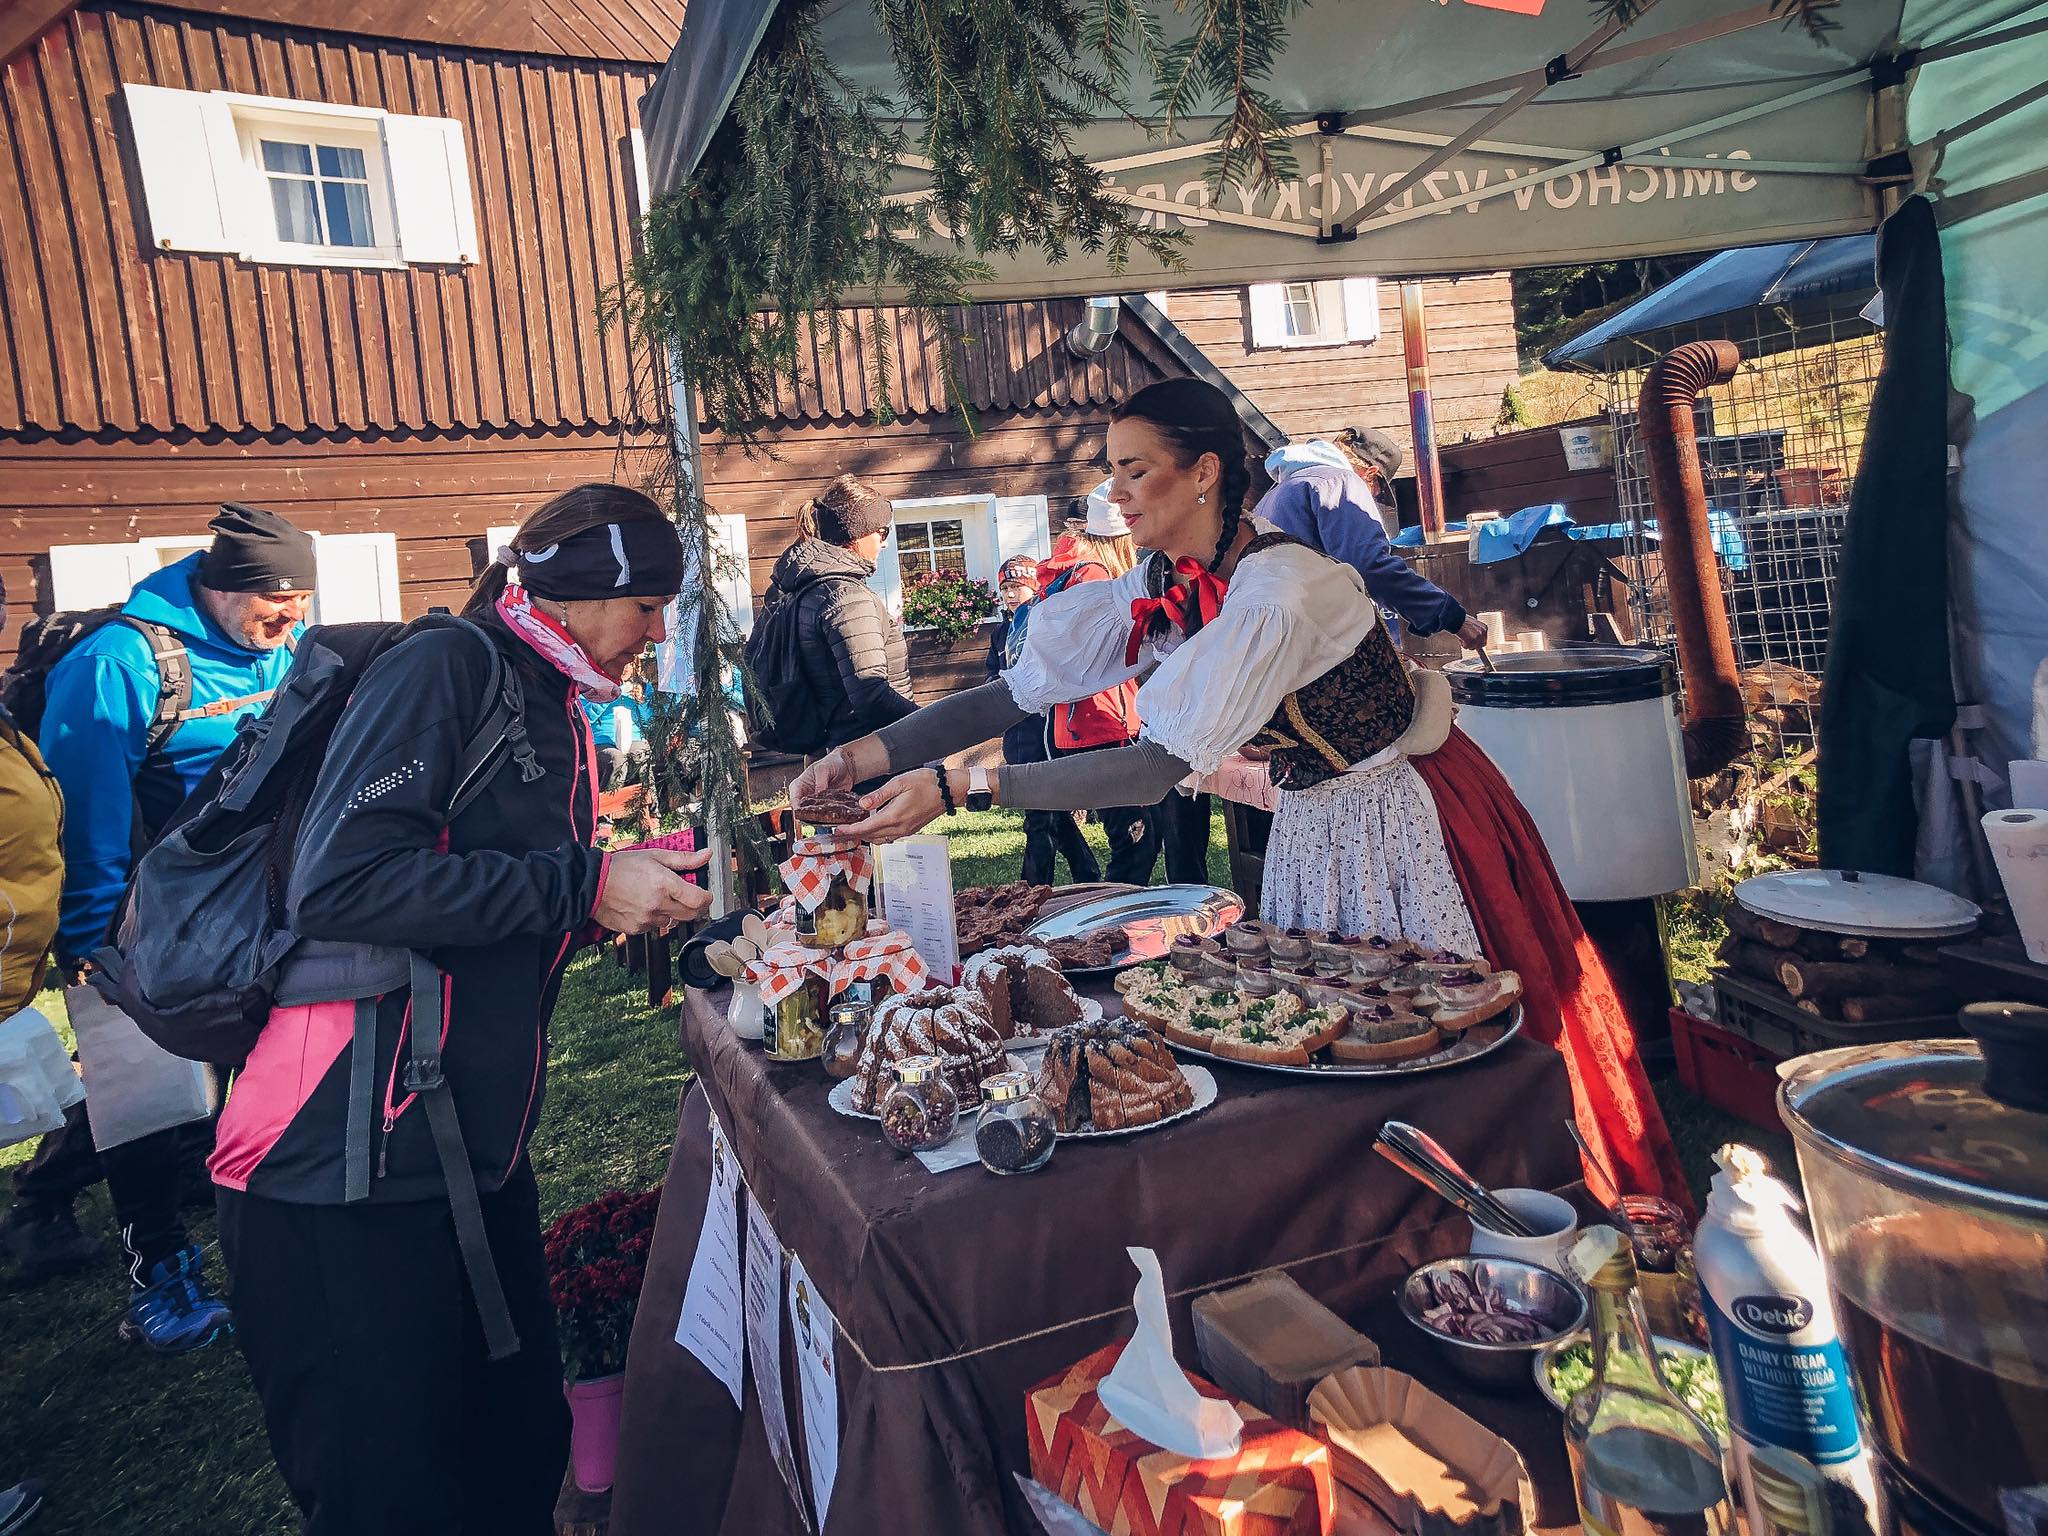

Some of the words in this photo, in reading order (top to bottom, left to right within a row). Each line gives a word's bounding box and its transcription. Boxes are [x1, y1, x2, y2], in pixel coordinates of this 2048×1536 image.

[1746, 1304, 1805, 1327] Debic
[1739, 1343, 1779, 1366] DAIRY
[1783, 1352, 1826, 1370] CREAM
[1741, 1359, 1799, 1385] WITHOUT
[1801, 1367, 1836, 1387] SUGAR
